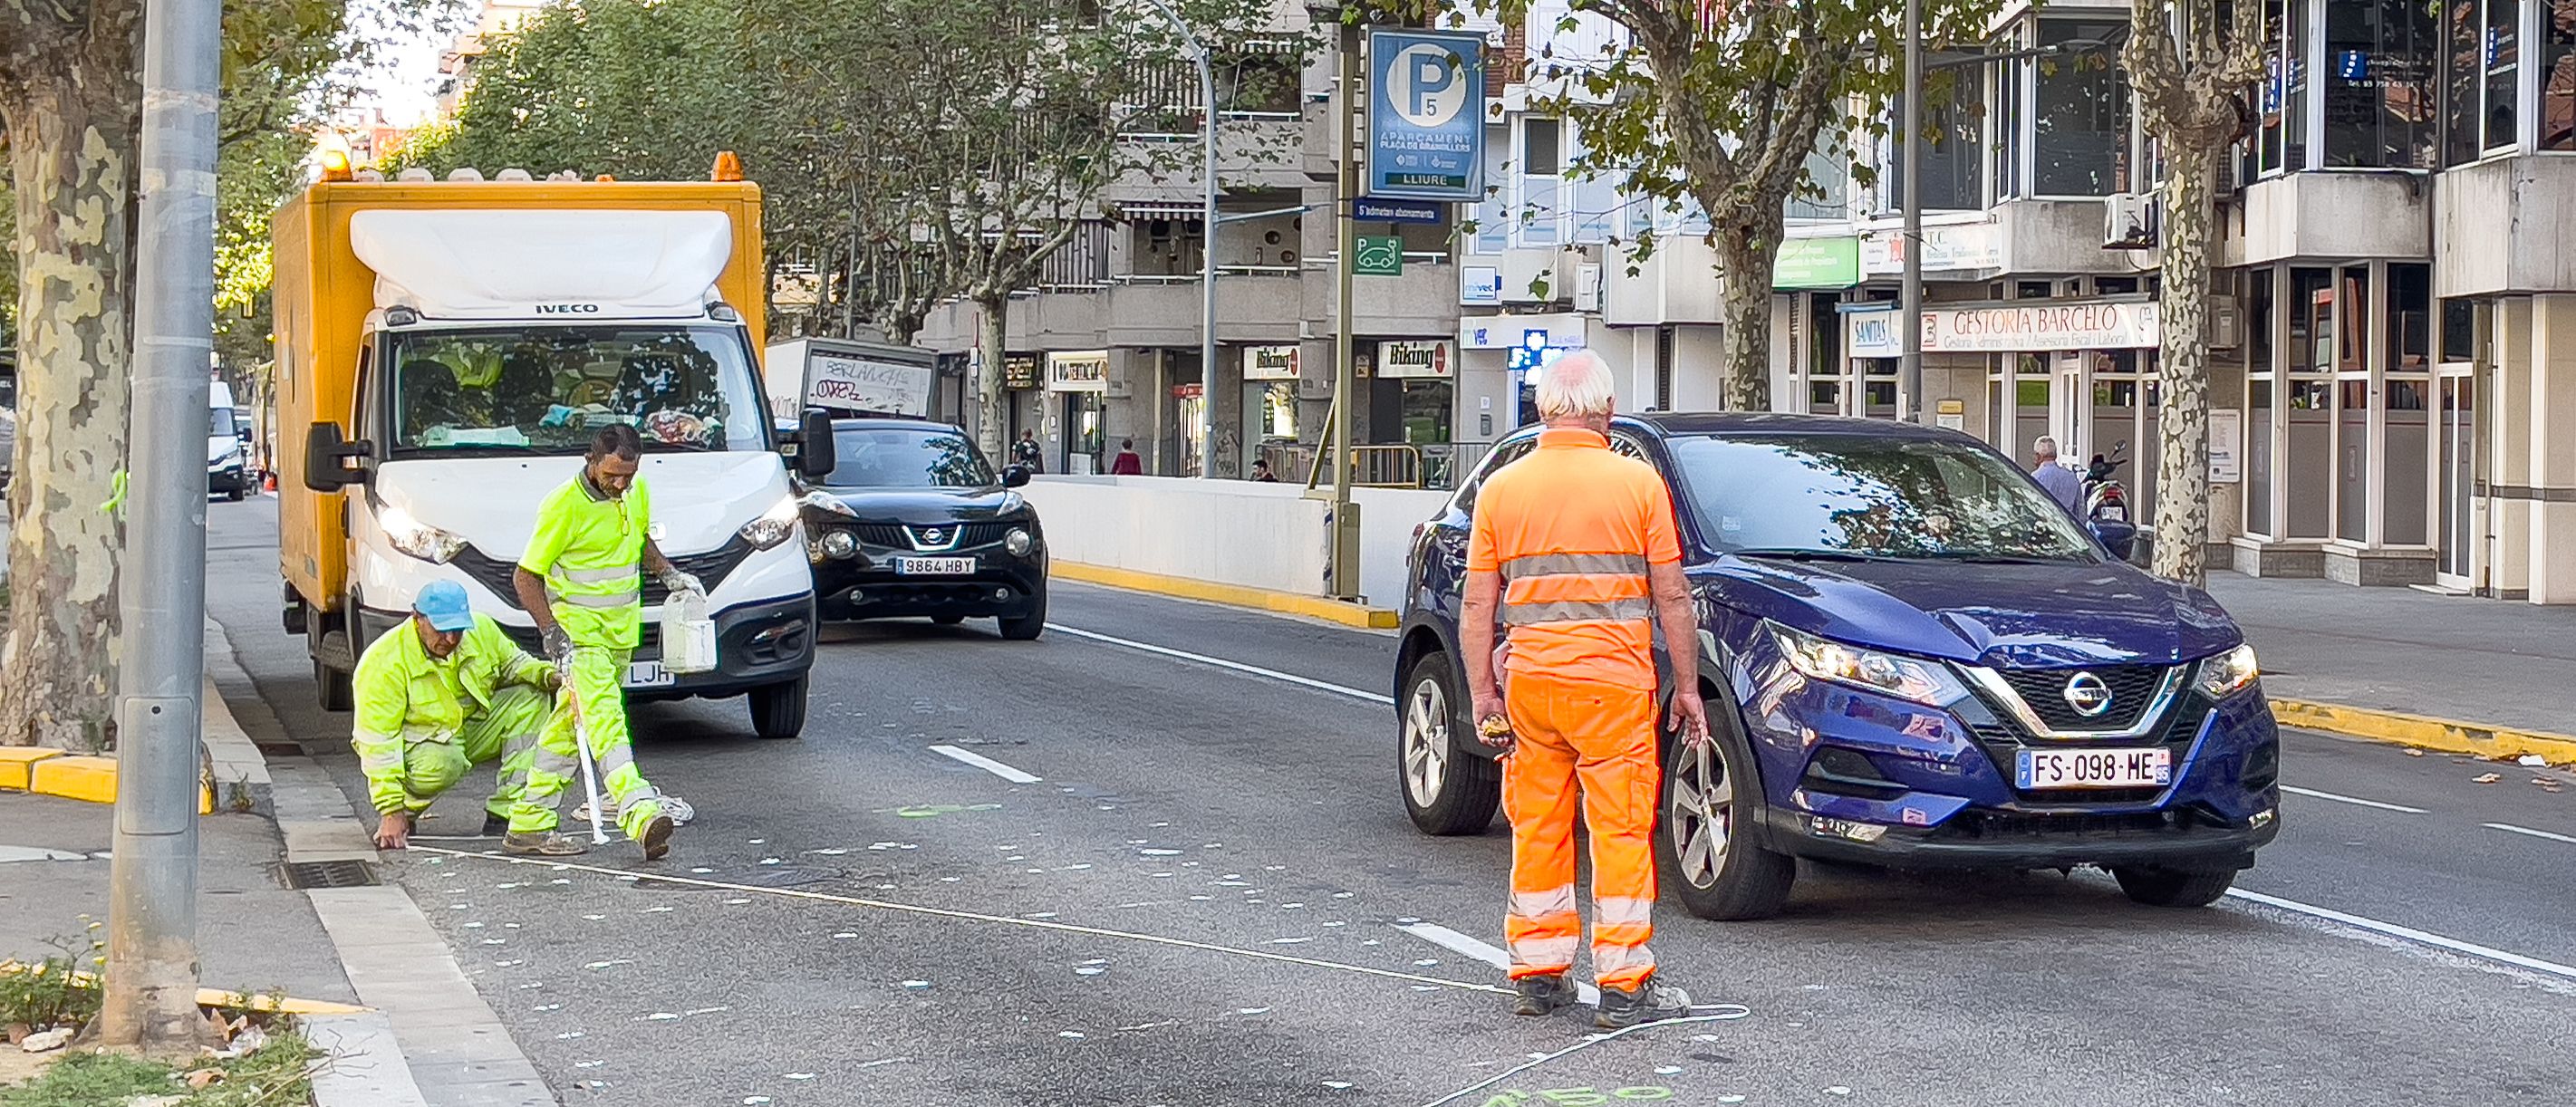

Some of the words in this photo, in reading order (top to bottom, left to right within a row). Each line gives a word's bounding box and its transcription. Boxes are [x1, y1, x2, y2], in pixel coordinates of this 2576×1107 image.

[1409, 53, 1453, 116] P
[1426, 98, 1437, 116] 5
[1403, 174, 1448, 187] LLIURE
[1357, 238, 1367, 252] P
[535, 303, 599, 314] IVECO
[1954, 309, 2031, 335] GESTORIA
[1257, 347, 1290, 371] Biking
[1390, 341, 1433, 370] Biking
[906, 560, 941, 573] 9864
[945, 560, 971, 573] HBY
[2035, 753, 2154, 783] FS-098-ME
